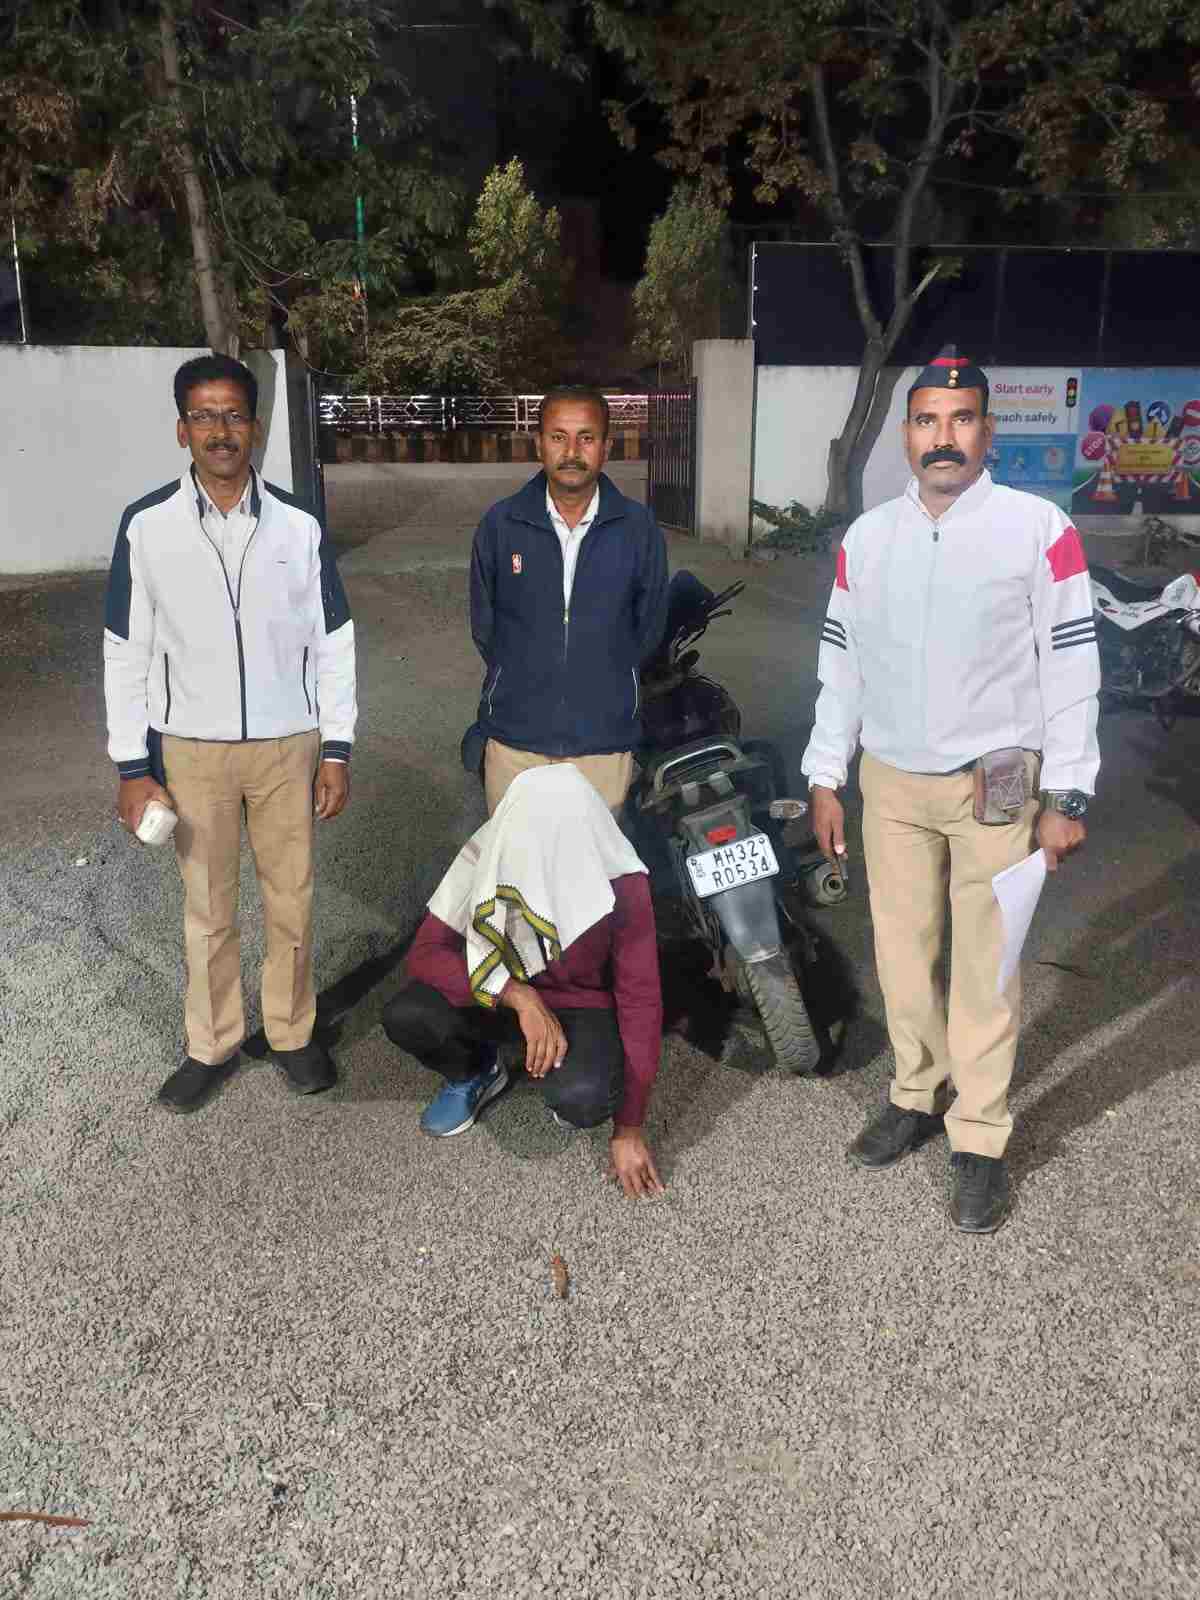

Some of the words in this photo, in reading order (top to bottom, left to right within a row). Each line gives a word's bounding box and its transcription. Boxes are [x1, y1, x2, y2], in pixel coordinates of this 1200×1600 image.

[994, 383, 1023, 394] Start
[1024, 384, 1055, 396] early
[993, 412, 1023, 423] each
[1024, 412, 1057, 424] safely
[713, 840, 759, 868] MH32
